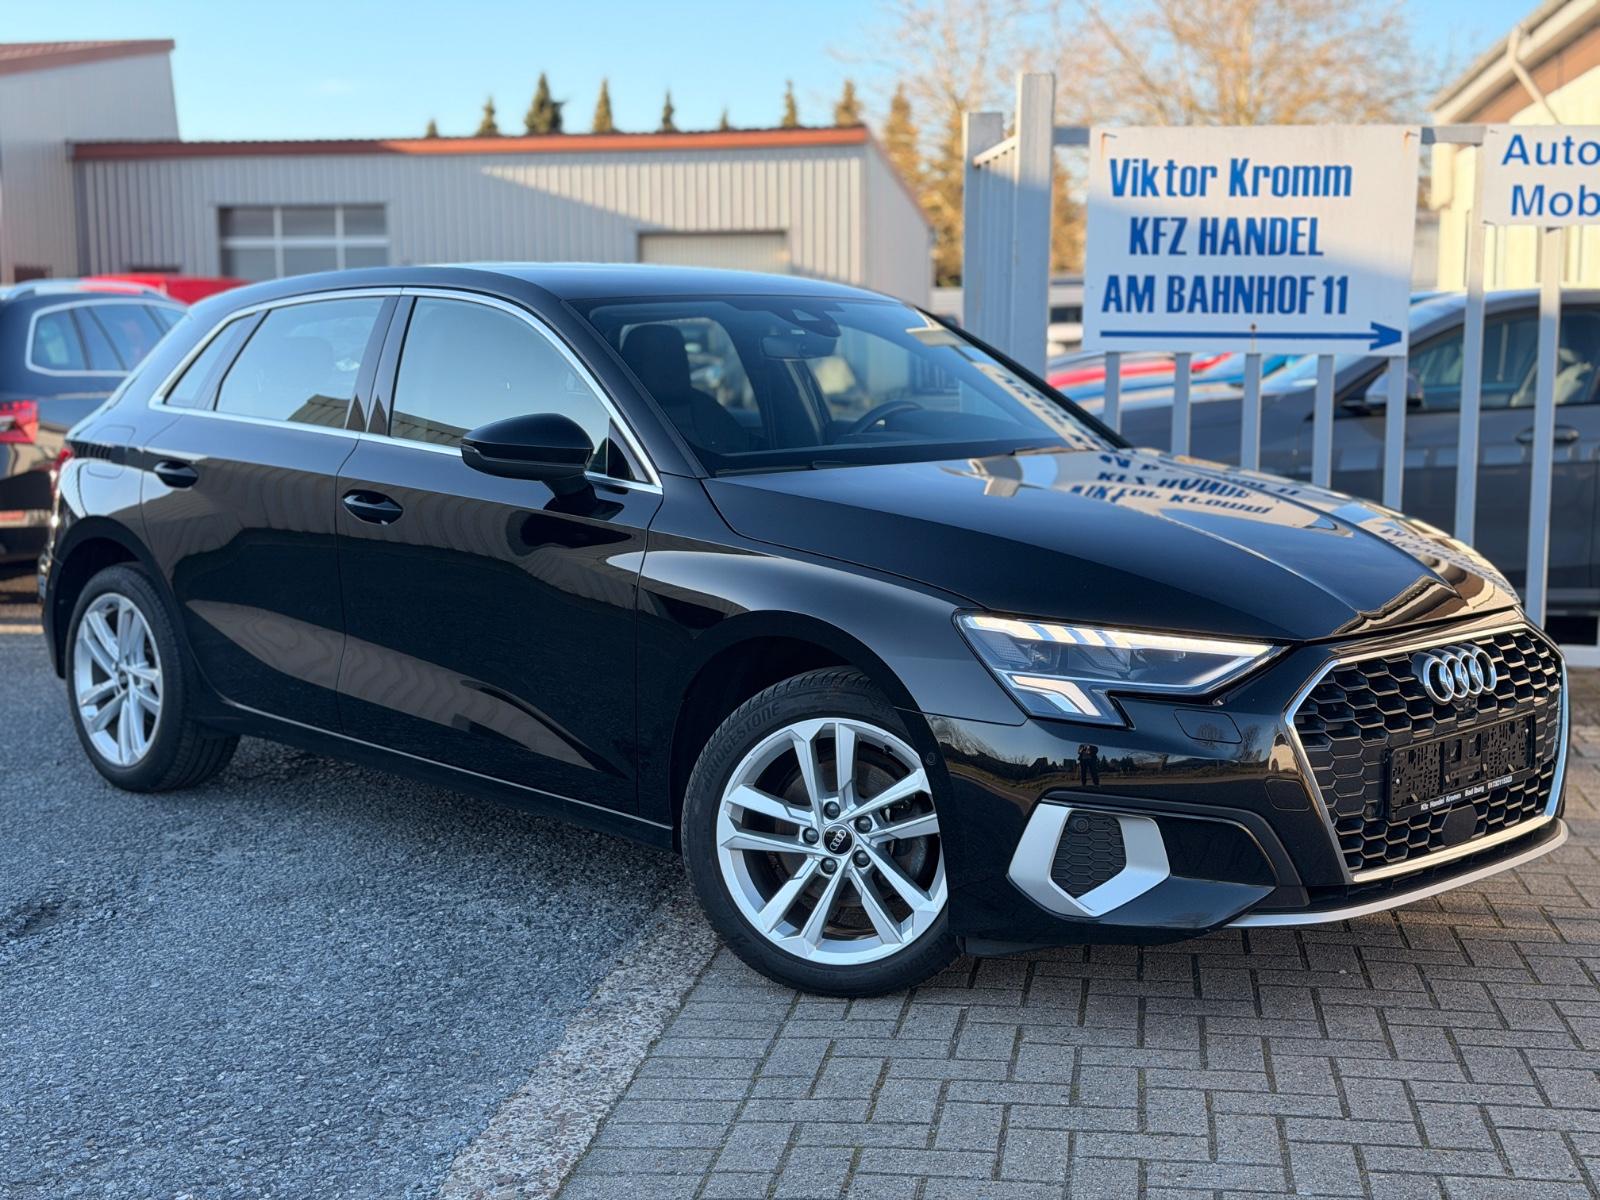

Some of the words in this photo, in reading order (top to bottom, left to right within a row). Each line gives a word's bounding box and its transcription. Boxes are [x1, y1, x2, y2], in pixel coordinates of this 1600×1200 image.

[1502, 134, 1600, 166] Auto
[1110, 158, 1218, 198] Viktor
[1229, 158, 1352, 198] Kromm
[1511, 184, 1600, 217] Mob
[1128, 215, 1188, 257] KFZ
[1198, 217, 1324, 257] HANDEL
[1100, 273, 1157, 315] AM
[1165, 273, 1317, 316] BAHNHOF
[1321, 274, 1349, 316] 11
